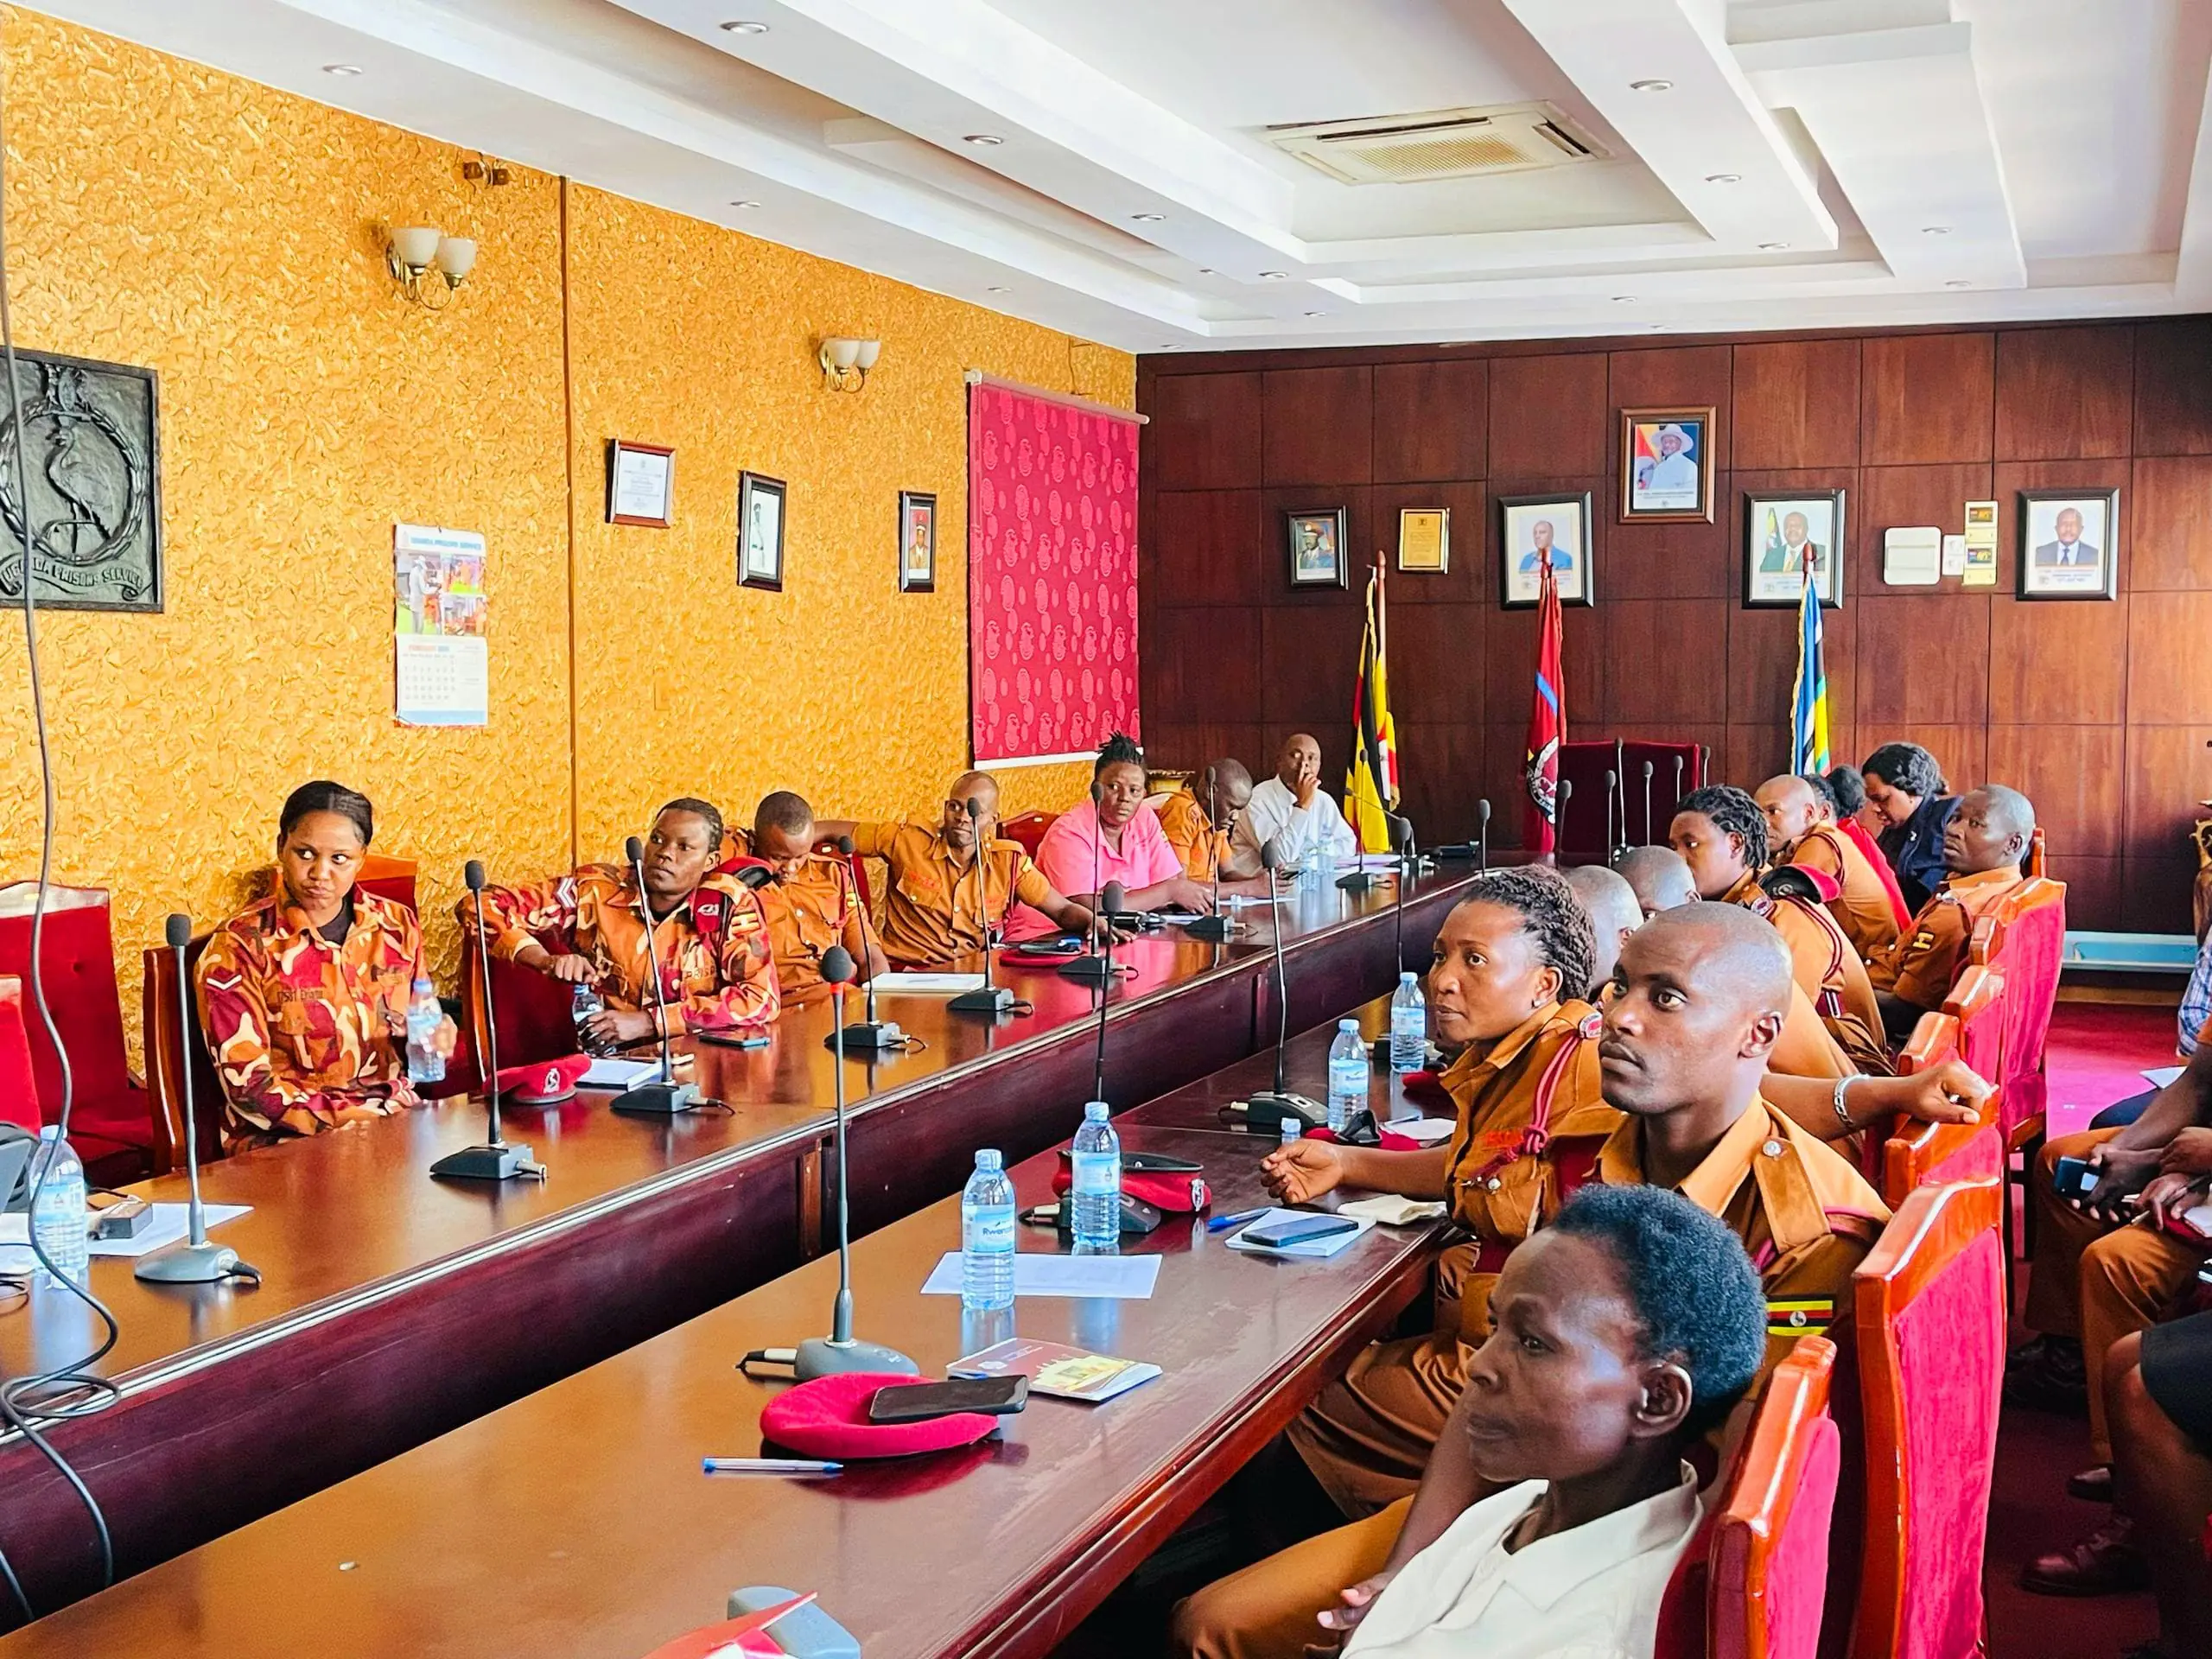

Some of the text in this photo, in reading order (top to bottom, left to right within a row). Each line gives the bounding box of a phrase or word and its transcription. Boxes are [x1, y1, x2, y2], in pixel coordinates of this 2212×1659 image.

[2, 556, 143, 589] UGDA PRISONS SERVICE
